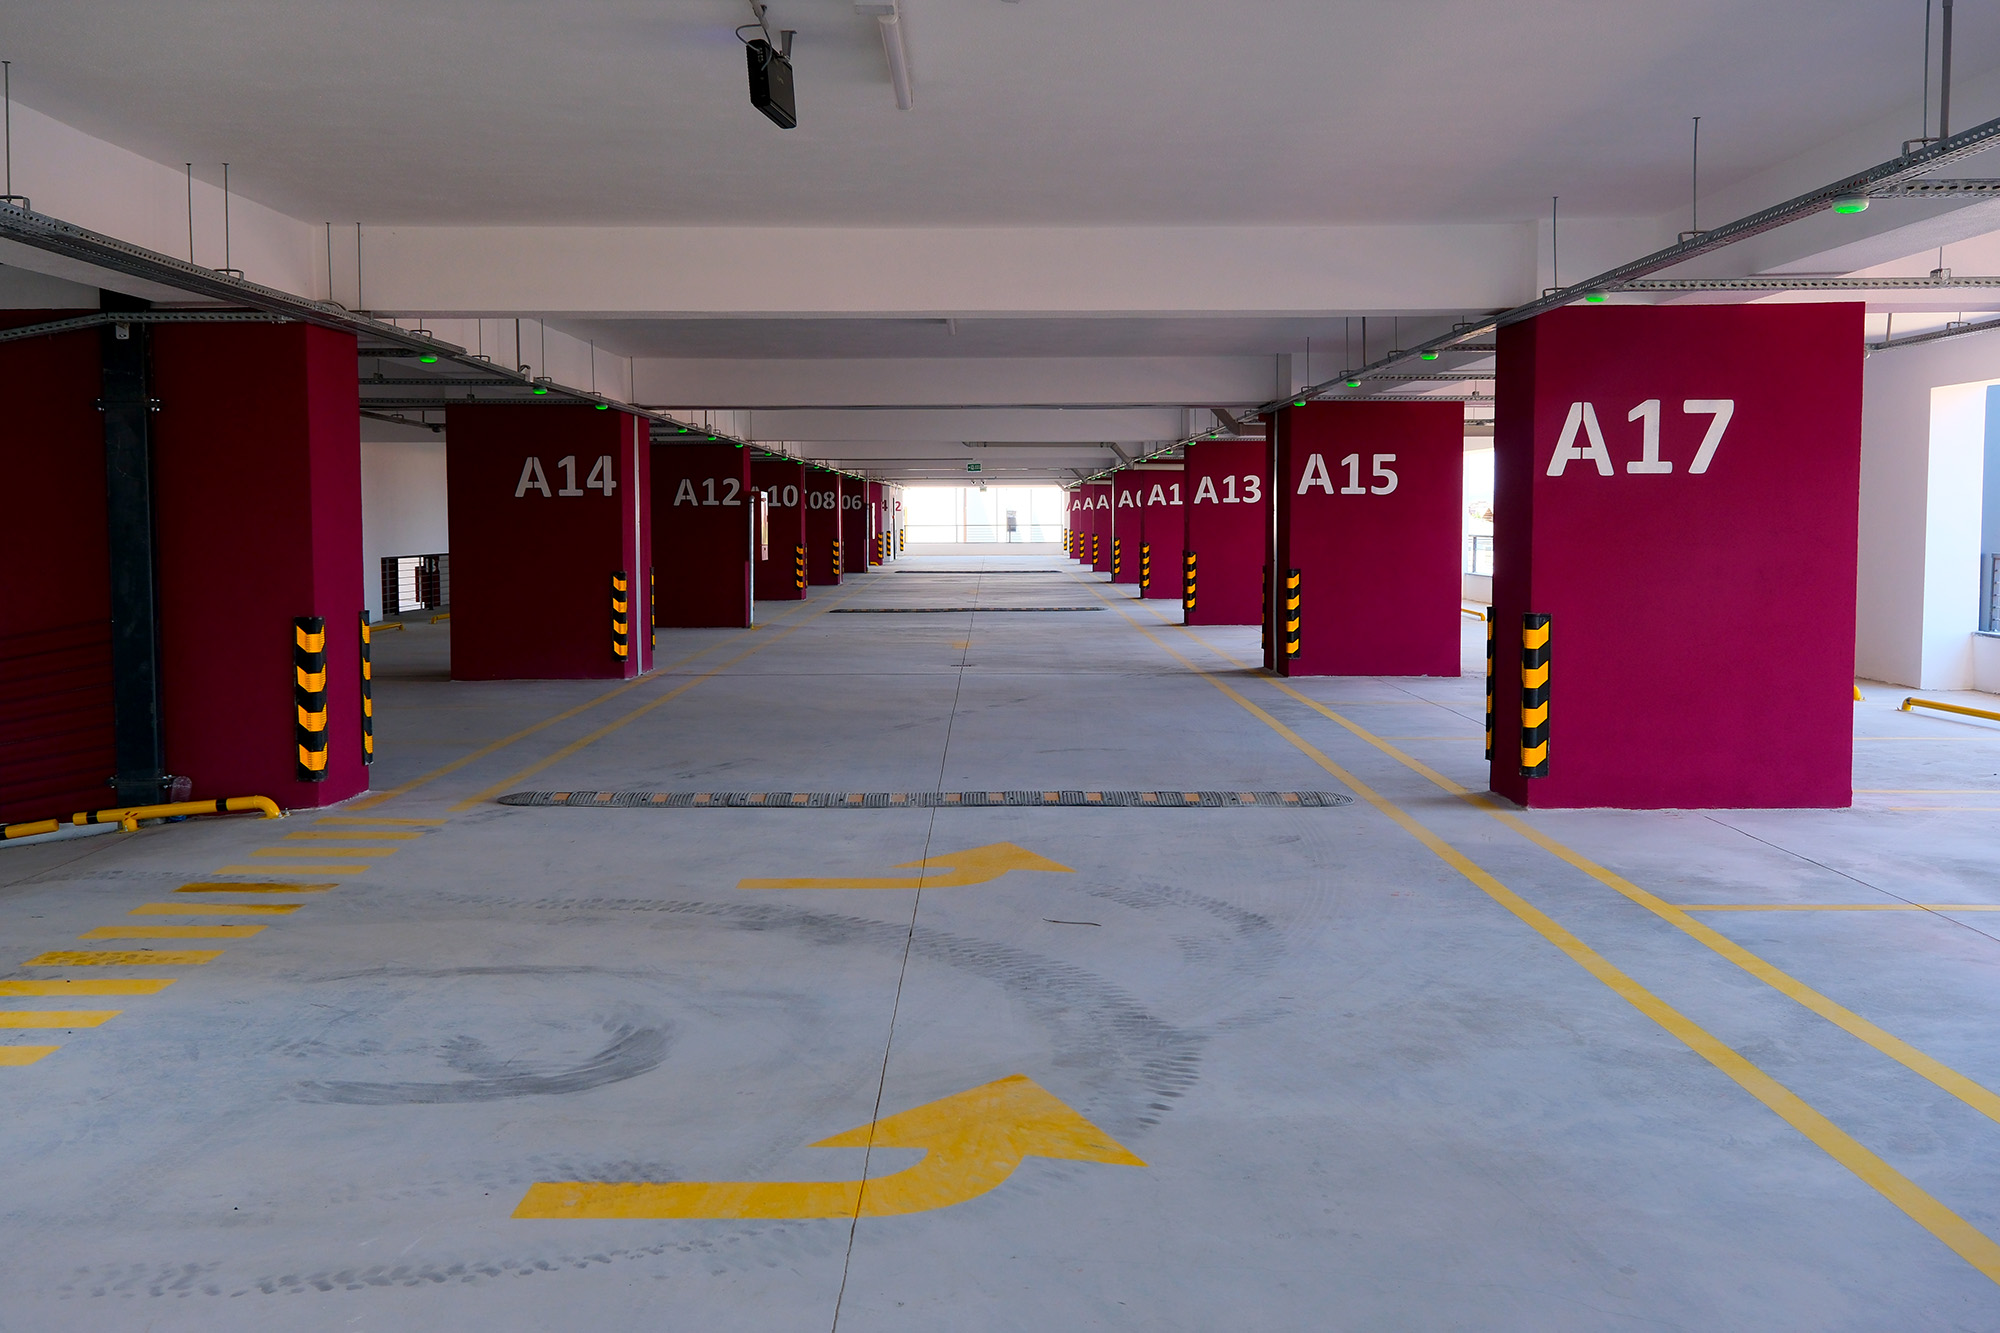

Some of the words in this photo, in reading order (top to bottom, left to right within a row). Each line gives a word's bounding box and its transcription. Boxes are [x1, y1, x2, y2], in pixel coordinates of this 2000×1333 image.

[1546, 399, 1735, 476] A17
[514, 455, 617, 497] A14
[1193, 474, 1262, 504] A13
[1296, 453, 1399, 496] A15
[673, 477, 741, 506] A12
[805, 489, 836, 510] 08
[842, 495, 862, 510] 06
[1147, 483, 1184, 506] A1
